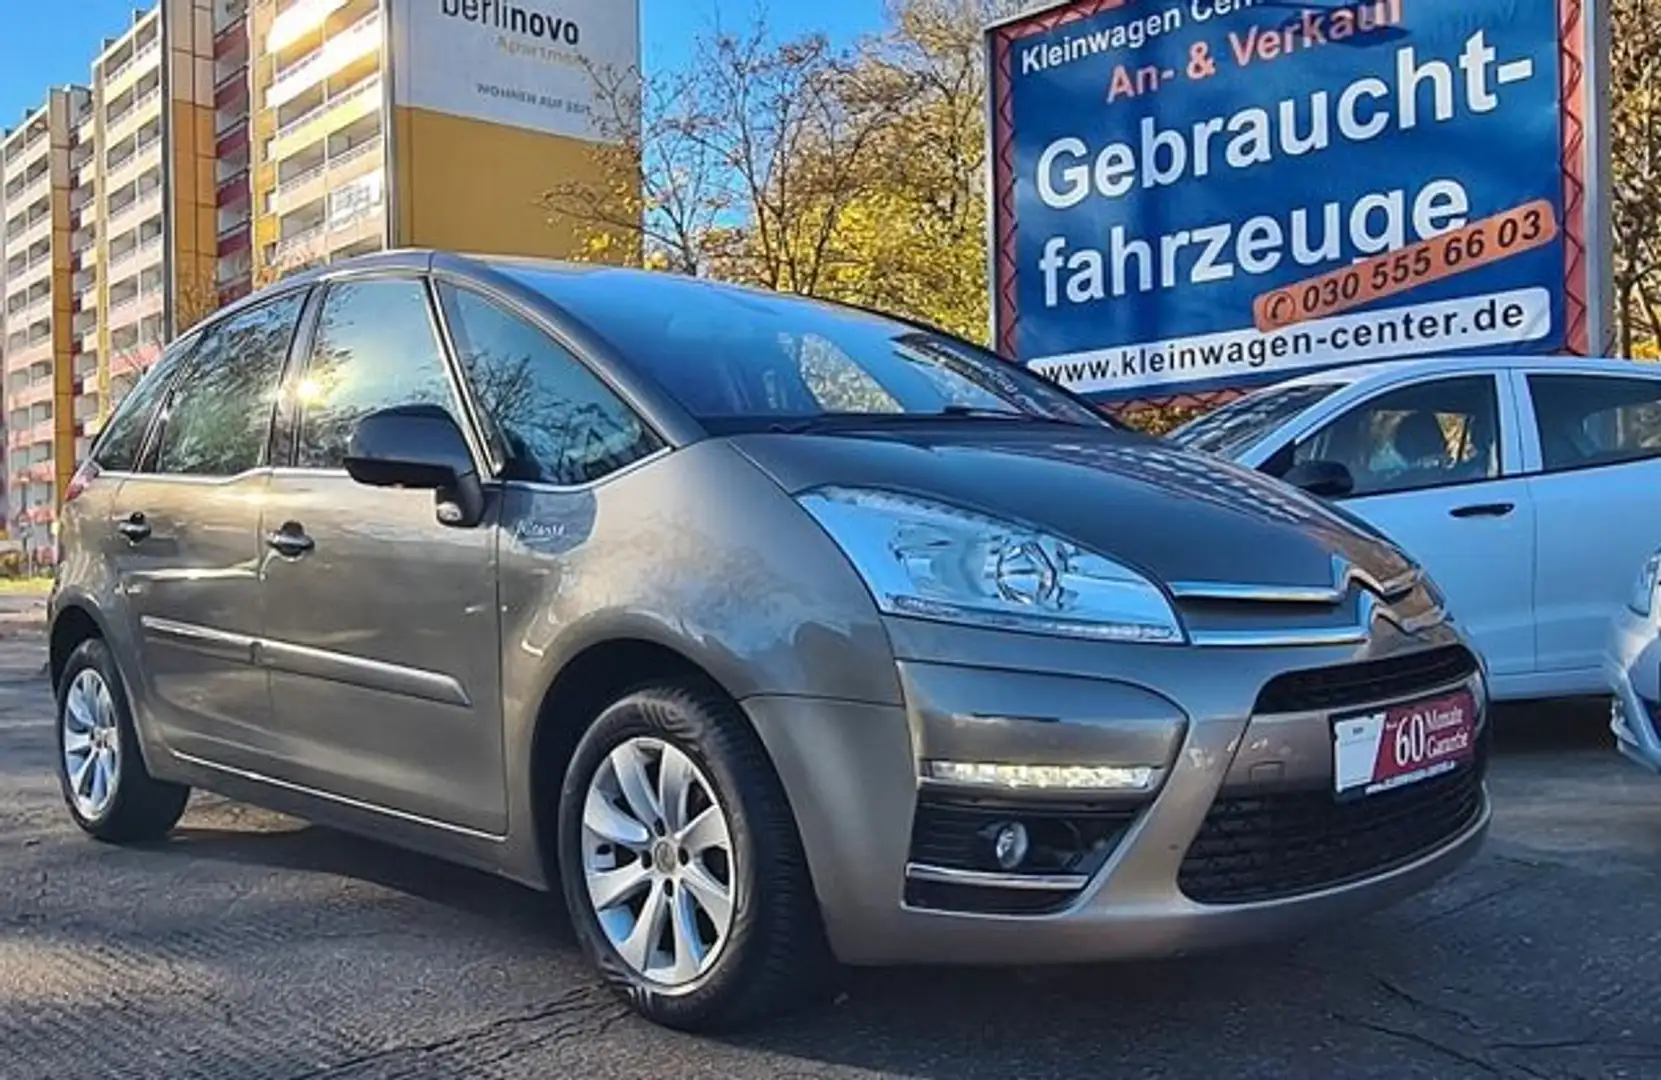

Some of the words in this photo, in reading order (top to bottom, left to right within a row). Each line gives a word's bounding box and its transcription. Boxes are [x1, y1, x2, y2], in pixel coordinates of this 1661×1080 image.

[443, 0, 579, 45] berlinovo
[1021, 8, 1181, 75] Kleinwagen
[1107, 63, 1175, 104] An-
[1186, 41, 1217, 80] &
[1037, 29, 1533, 209] Gebraucht-
[1039, 176, 1469, 307] fahrzeuge
[1302, 272, 1360, 313] 030
[1371, 246, 1431, 290] 555
[1443, 229, 1485, 266] 66
[1498, 210, 1542, 248] 03
[1041, 299, 1525, 384] www.kleinwagen-center.de
[1396, 714, 1424, 767] 60
